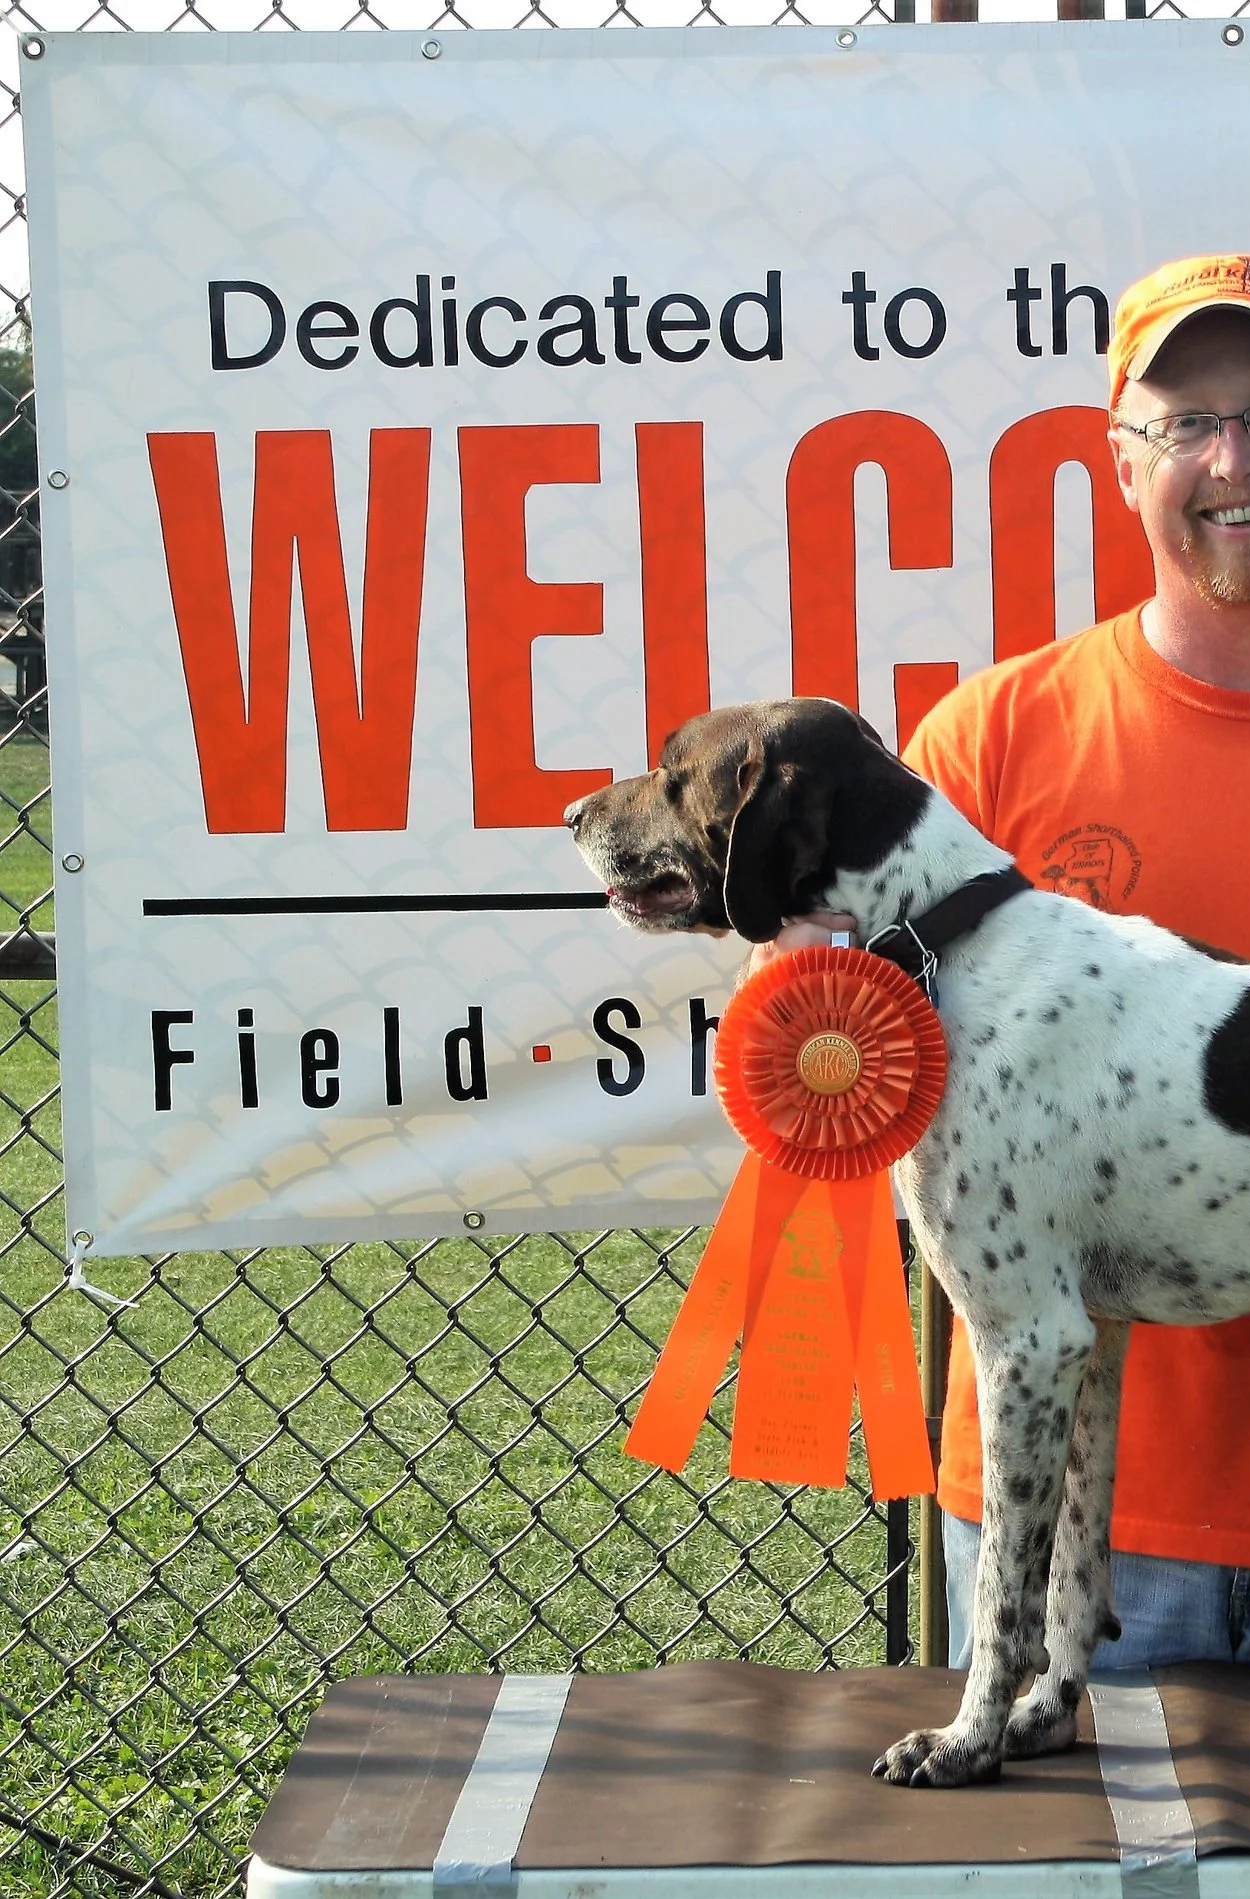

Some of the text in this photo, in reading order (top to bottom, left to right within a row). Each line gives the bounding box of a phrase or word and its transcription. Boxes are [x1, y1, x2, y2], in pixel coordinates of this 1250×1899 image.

[207, 270, 784, 371] Dedicated
[842, 270, 948, 361] to
[1006, 262, 1110, 357] th
[150, 1004, 489, 1112] Field
